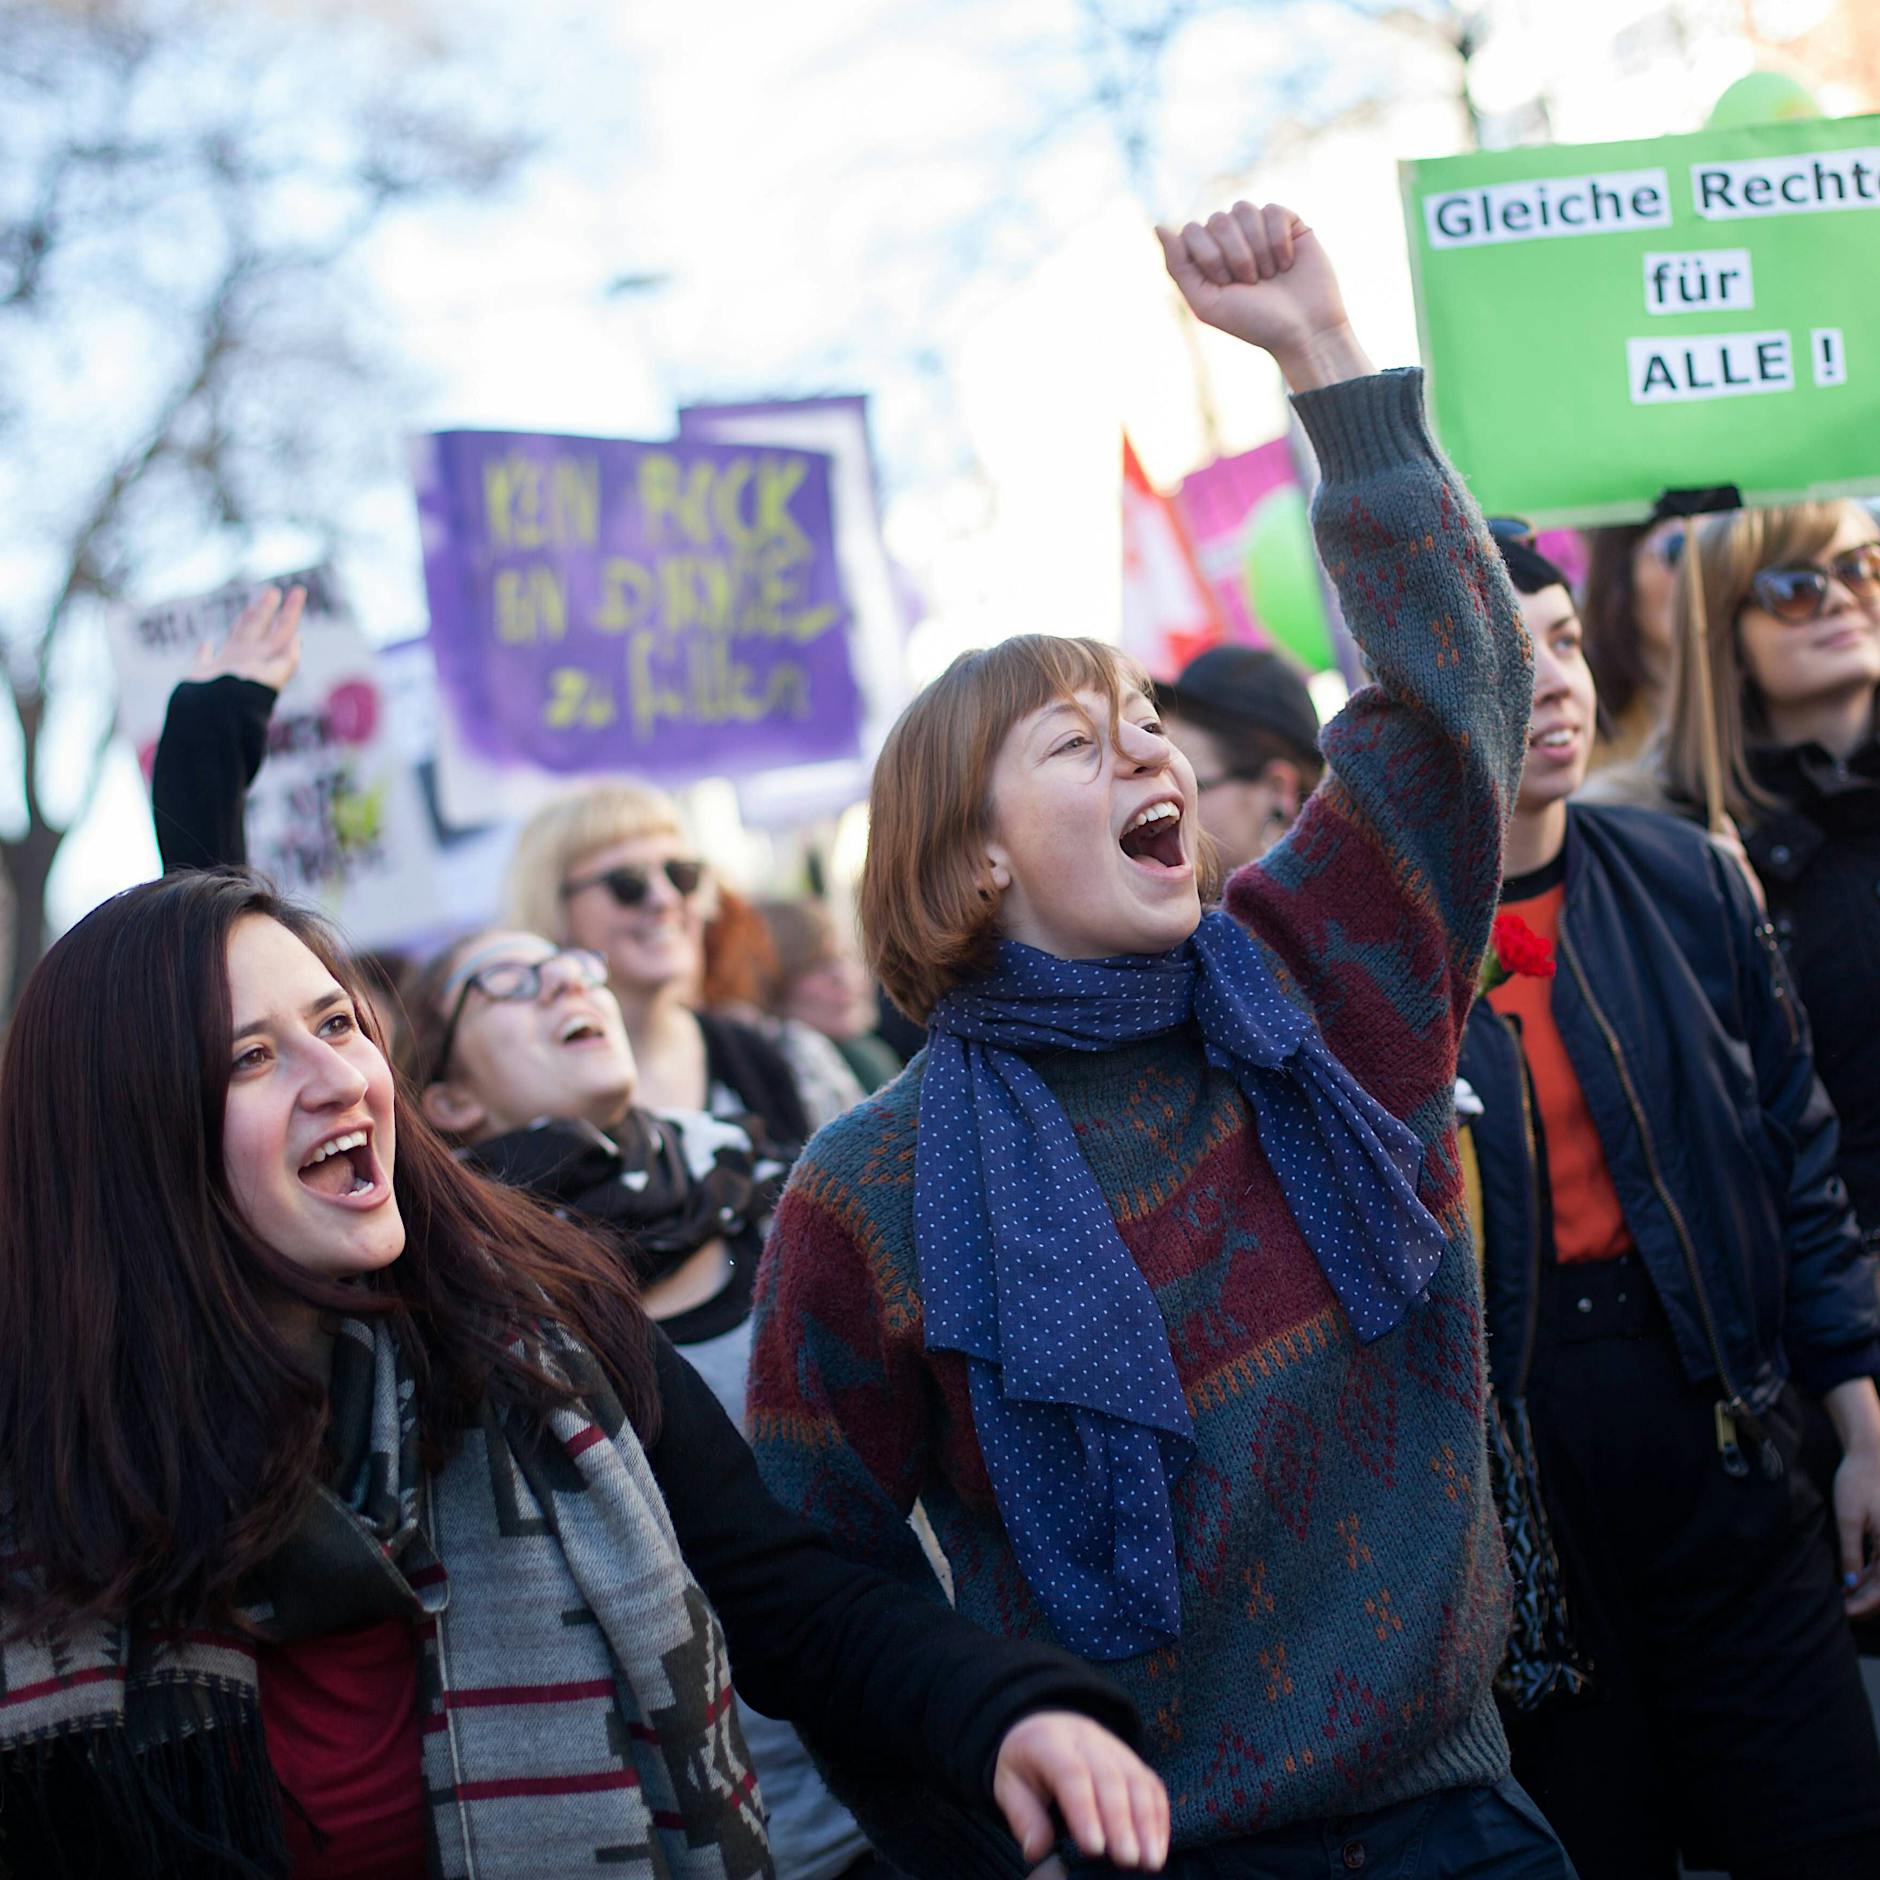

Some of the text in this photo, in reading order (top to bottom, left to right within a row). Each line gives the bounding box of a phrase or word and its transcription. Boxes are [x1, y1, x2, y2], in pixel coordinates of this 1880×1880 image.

[1436, 161, 1880, 238] Gleiche Recht
[1652, 260, 1742, 303] für
[1643, 336, 1836, 392] ALLE !
